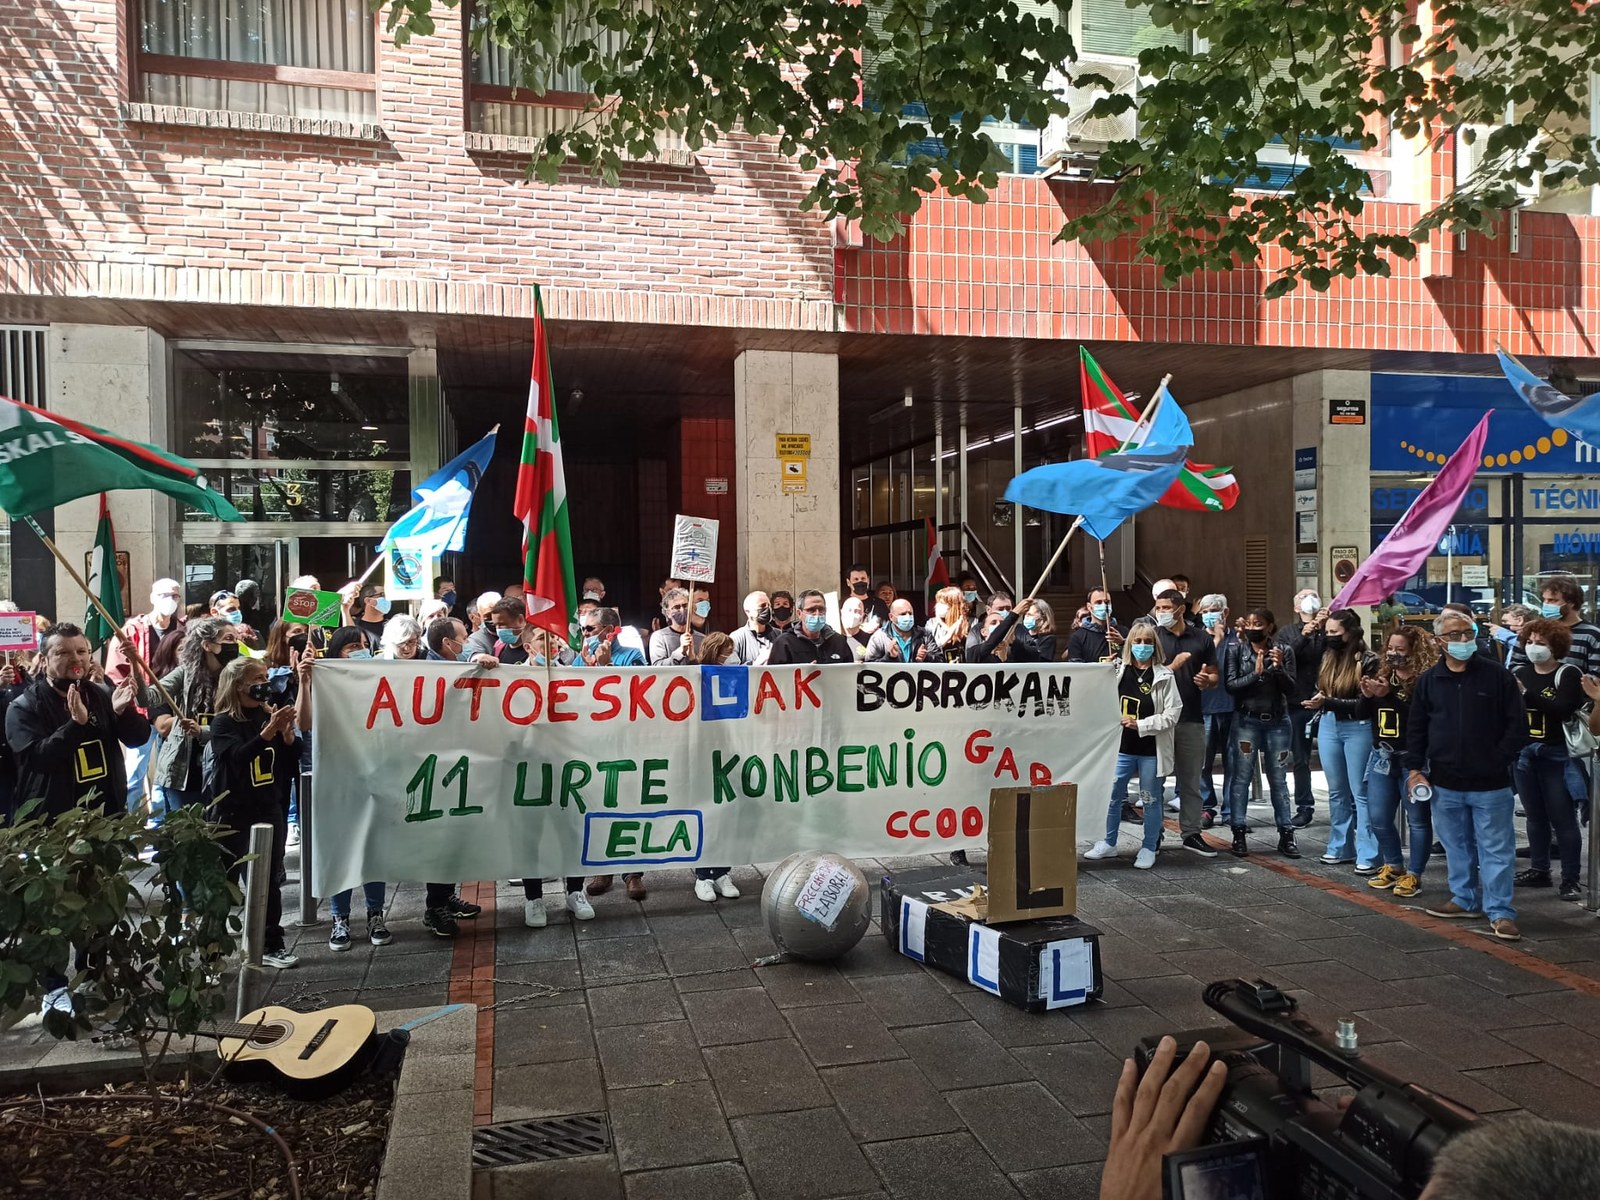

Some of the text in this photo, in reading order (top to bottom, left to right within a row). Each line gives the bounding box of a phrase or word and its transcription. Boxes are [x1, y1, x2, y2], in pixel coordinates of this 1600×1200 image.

[286, 483, 302, 506] 3
[1529, 484, 1600, 509] TÉCNI
[293, 598, 316, 608] STOP
[366, 667, 1072, 730] AUTOESKOLAK BORROKAN
[77, 747, 103, 778] L
[404, 753, 483, 823] 11
[513, 758, 670, 814] URTE
[604, 819, 693, 858] ELA
[885, 805, 984, 838] CCOO
[1016, 792, 1064, 911] L
[1052, 948, 1087, 1002] L
